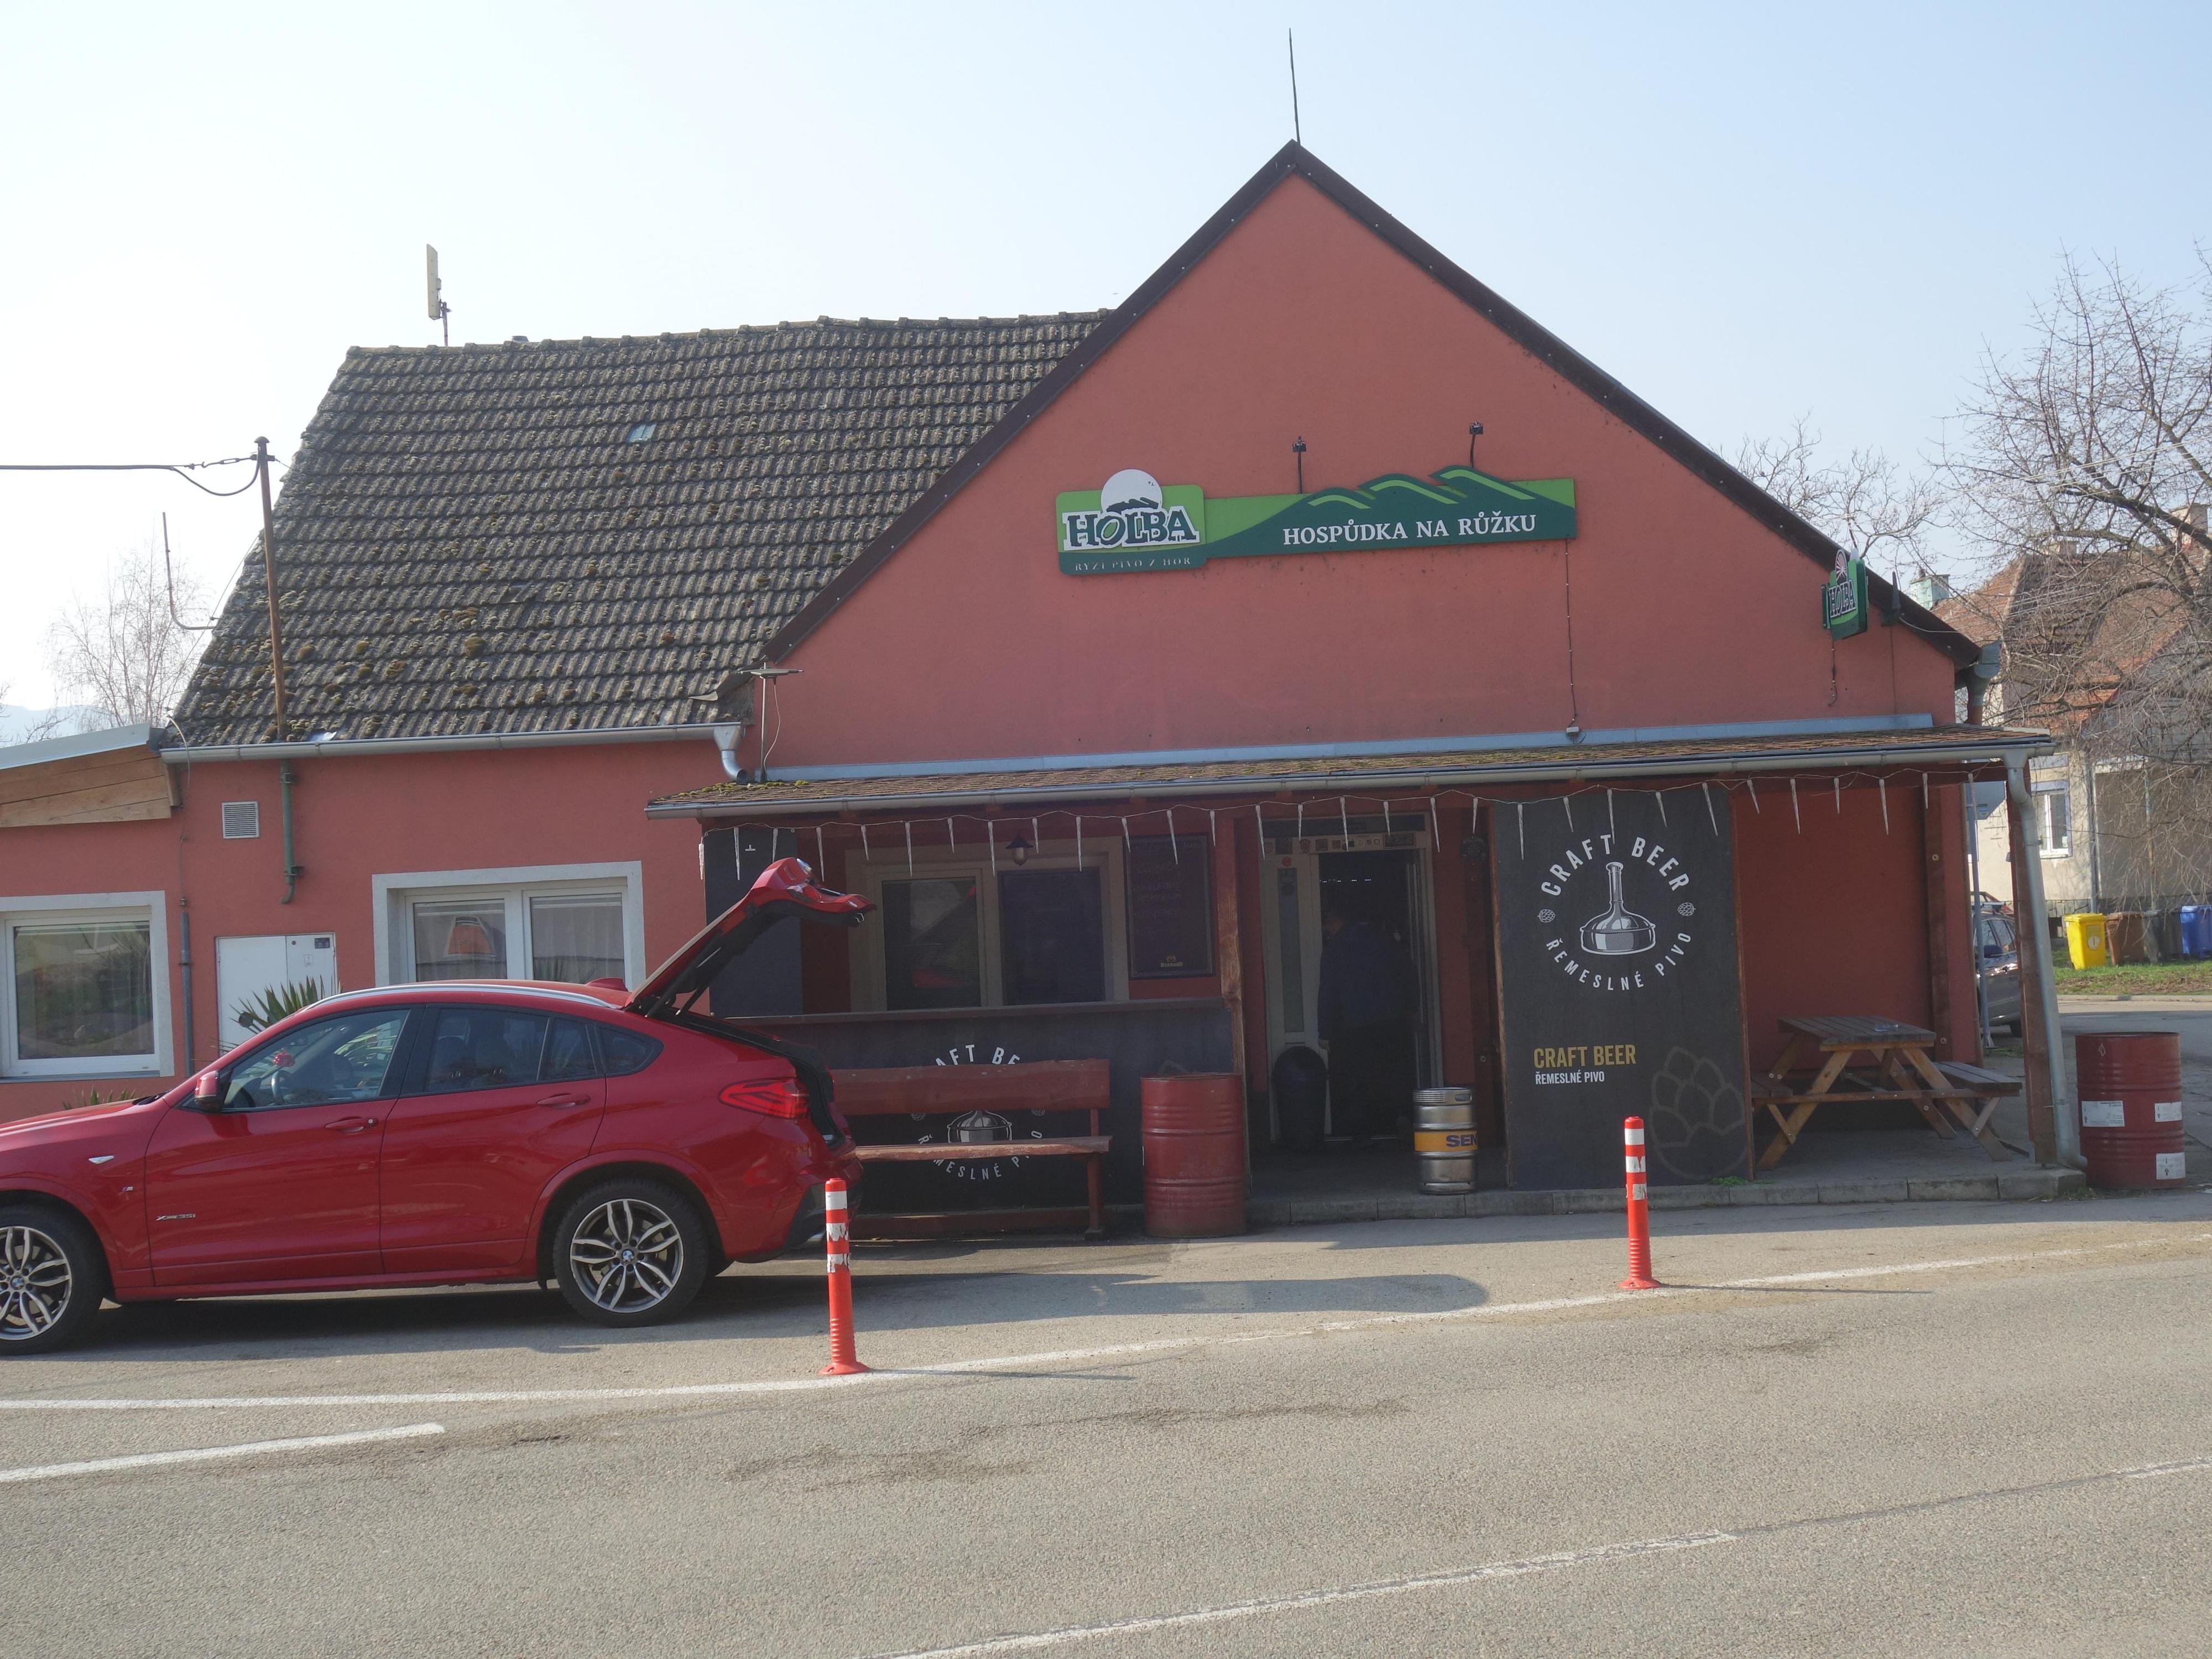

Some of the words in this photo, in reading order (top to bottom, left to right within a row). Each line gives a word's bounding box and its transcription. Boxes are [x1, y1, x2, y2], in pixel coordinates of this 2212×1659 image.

[1062, 506, 1199, 550] HOLBA
[1283, 519, 1408, 545] HOSPŮDKA
[1416, 520, 1449, 538] NA
[1458, 510, 1537, 535] RŮŽKU
[1829, 580, 1856, 618] HOLBA
[1541, 834, 1611, 896] CRAFT
[1632, 837, 1689, 891] BEER
[1546, 938, 1644, 990] ŘEMESLNÉ
[1655, 933, 1691, 976] PIVO
[992, 1047, 1020, 1065] BE
[1534, 1046, 1588, 1068] CRAFT
[1594, 1045, 1636, 1066] BEER
[1535, 1070, 1582, 1085] ŘEMESLNÉ
[1584, 1071, 1605, 1083] PIVO
